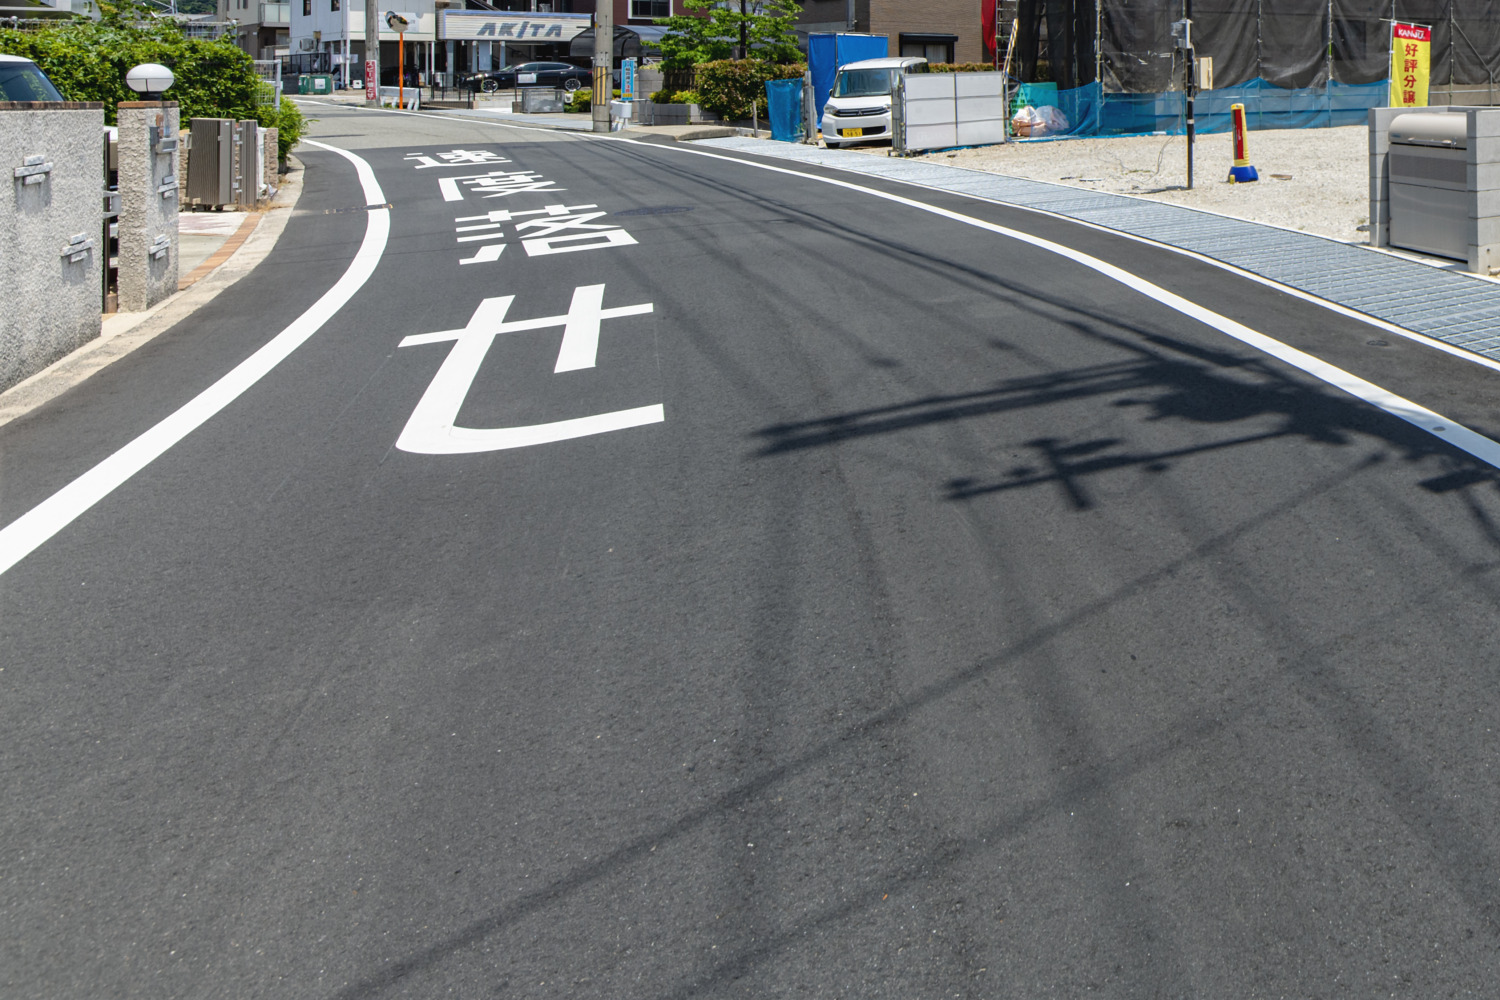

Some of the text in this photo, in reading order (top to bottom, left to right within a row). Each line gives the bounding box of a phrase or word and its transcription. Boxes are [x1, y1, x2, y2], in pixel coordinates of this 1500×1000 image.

[476, 21, 562, 39] AKITA
[1403, 43, 1419, 107] 好評分譲
